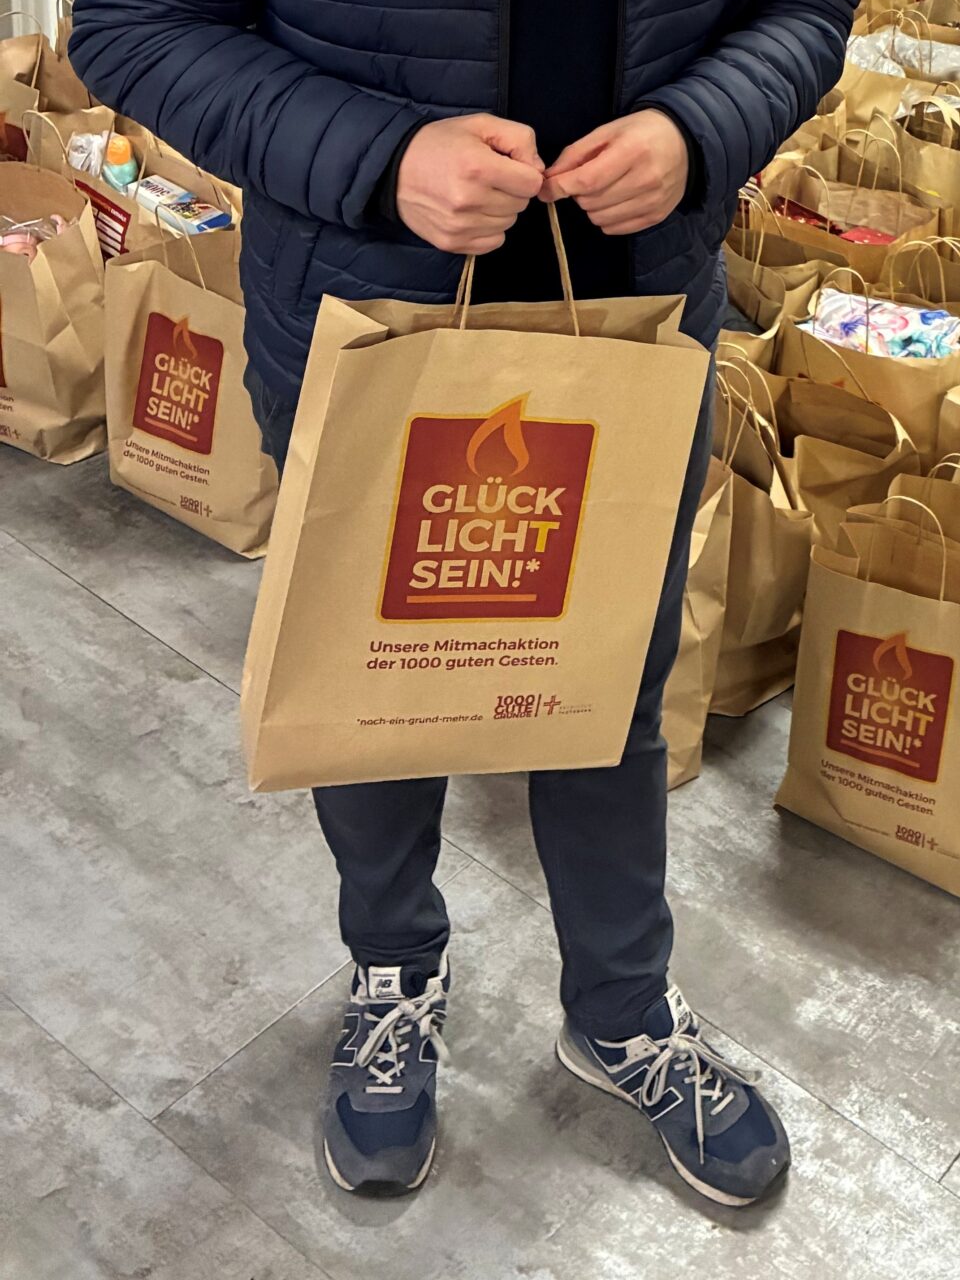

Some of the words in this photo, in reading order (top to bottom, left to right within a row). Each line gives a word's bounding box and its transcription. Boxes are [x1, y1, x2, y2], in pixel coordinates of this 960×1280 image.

[154, 352, 213, 391] GLÜCK
[151, 372, 209, 412] LICHT
[125, 439, 151, 456] Unsere
[151, 450, 210, 476] Mitmachaktion
[136, 454, 155, 467] 1000
[155, 461, 179, 477] guten
[422, 476, 567, 516] GLÜCK
[416, 518, 561, 553] LICHT
[366, 657, 396, 670] der
[399, 657, 441, 670] 1000
[445, 656, 495, 670] guten
[498, 654, 559, 667] Gesten.
[370, 640, 430, 653] Unsere
[434, 637, 560, 652] Mitmachaktion
[494, 704, 534, 716] GUTE
[497, 694, 536, 707] 1000
[847, 673, 937, 713] GLÜCK
[844, 694, 934, 736] LICHT
[821, 759, 856, 778] Unsere
[857, 773, 936, 806] Mitmachaktion
[838, 776, 864, 792] 1000
[864, 788, 895, 804] guten
